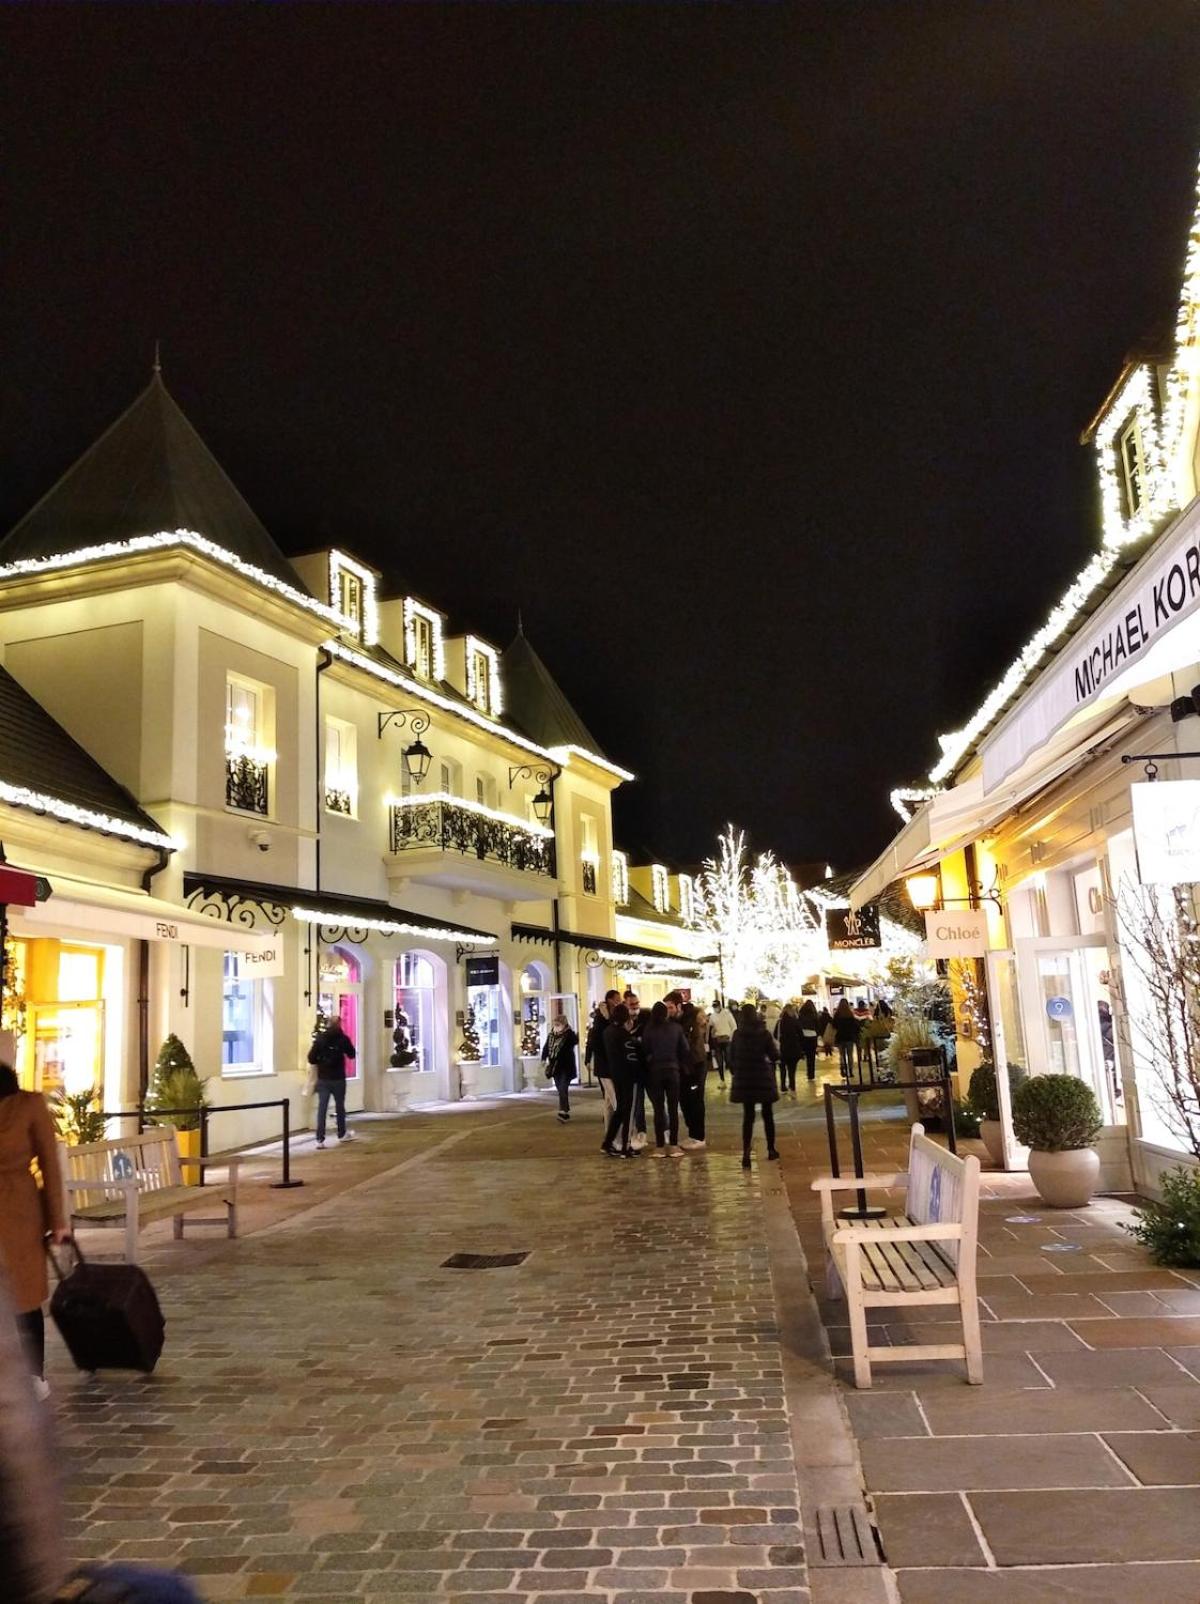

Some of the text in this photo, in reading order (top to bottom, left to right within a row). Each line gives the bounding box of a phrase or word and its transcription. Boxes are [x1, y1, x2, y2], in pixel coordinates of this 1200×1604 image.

[1074, 541, 1200, 703] MICHAEL KOR
[156, 922, 179, 939] FENDI
[935, 925, 981, 942] Chloé
[834, 936, 876, 948] MONCLER
[245, 949, 277, 964] FENDI
